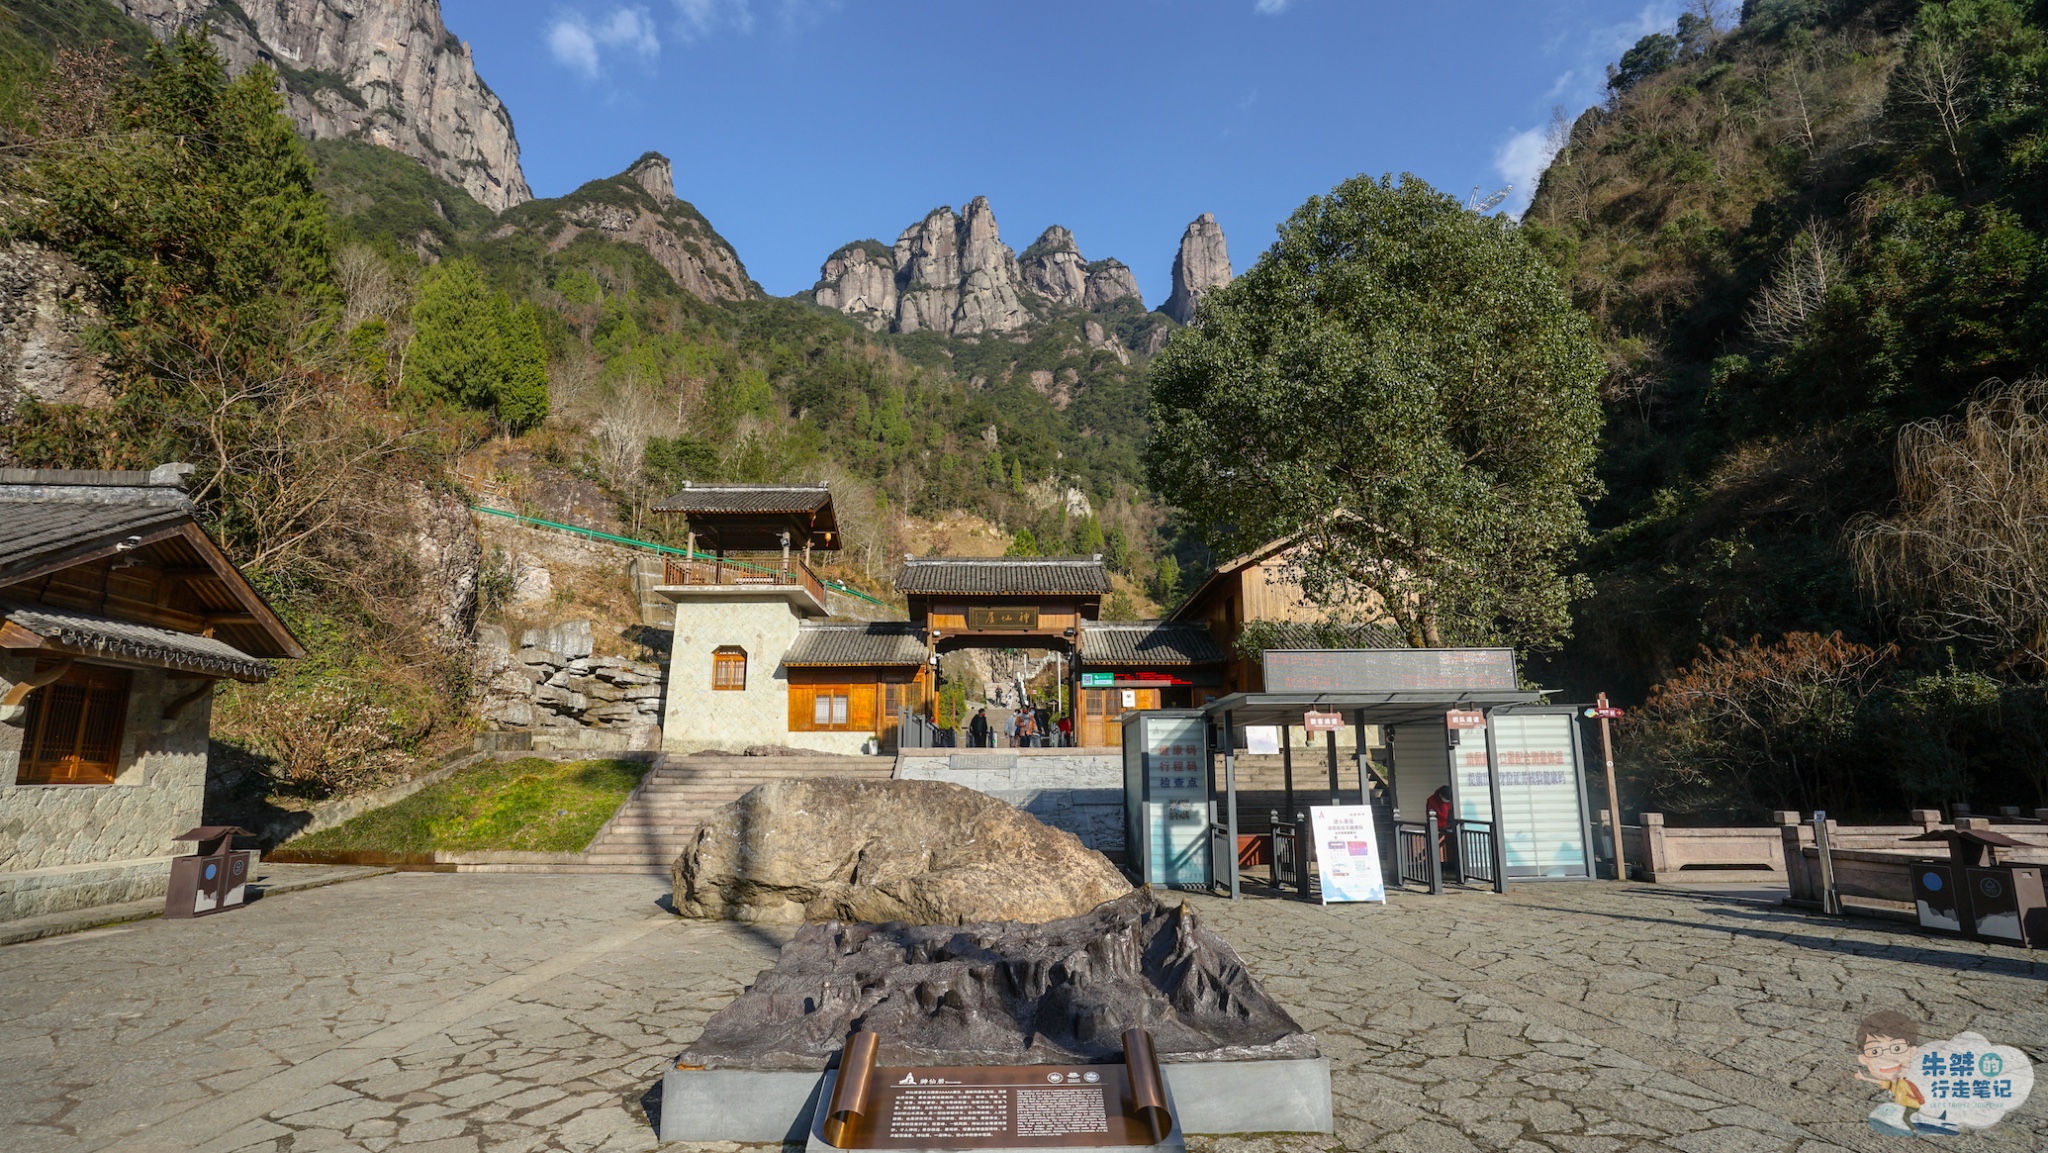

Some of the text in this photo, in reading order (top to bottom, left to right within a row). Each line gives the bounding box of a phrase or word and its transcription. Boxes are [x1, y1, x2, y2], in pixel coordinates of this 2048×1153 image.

[985, 611, 1030, 624] 神仙居
[1159, 745, 1197, 756] 健康码
[1159, 761, 1198, 772] 行程码
[1160, 777, 1198, 788] 检查点
